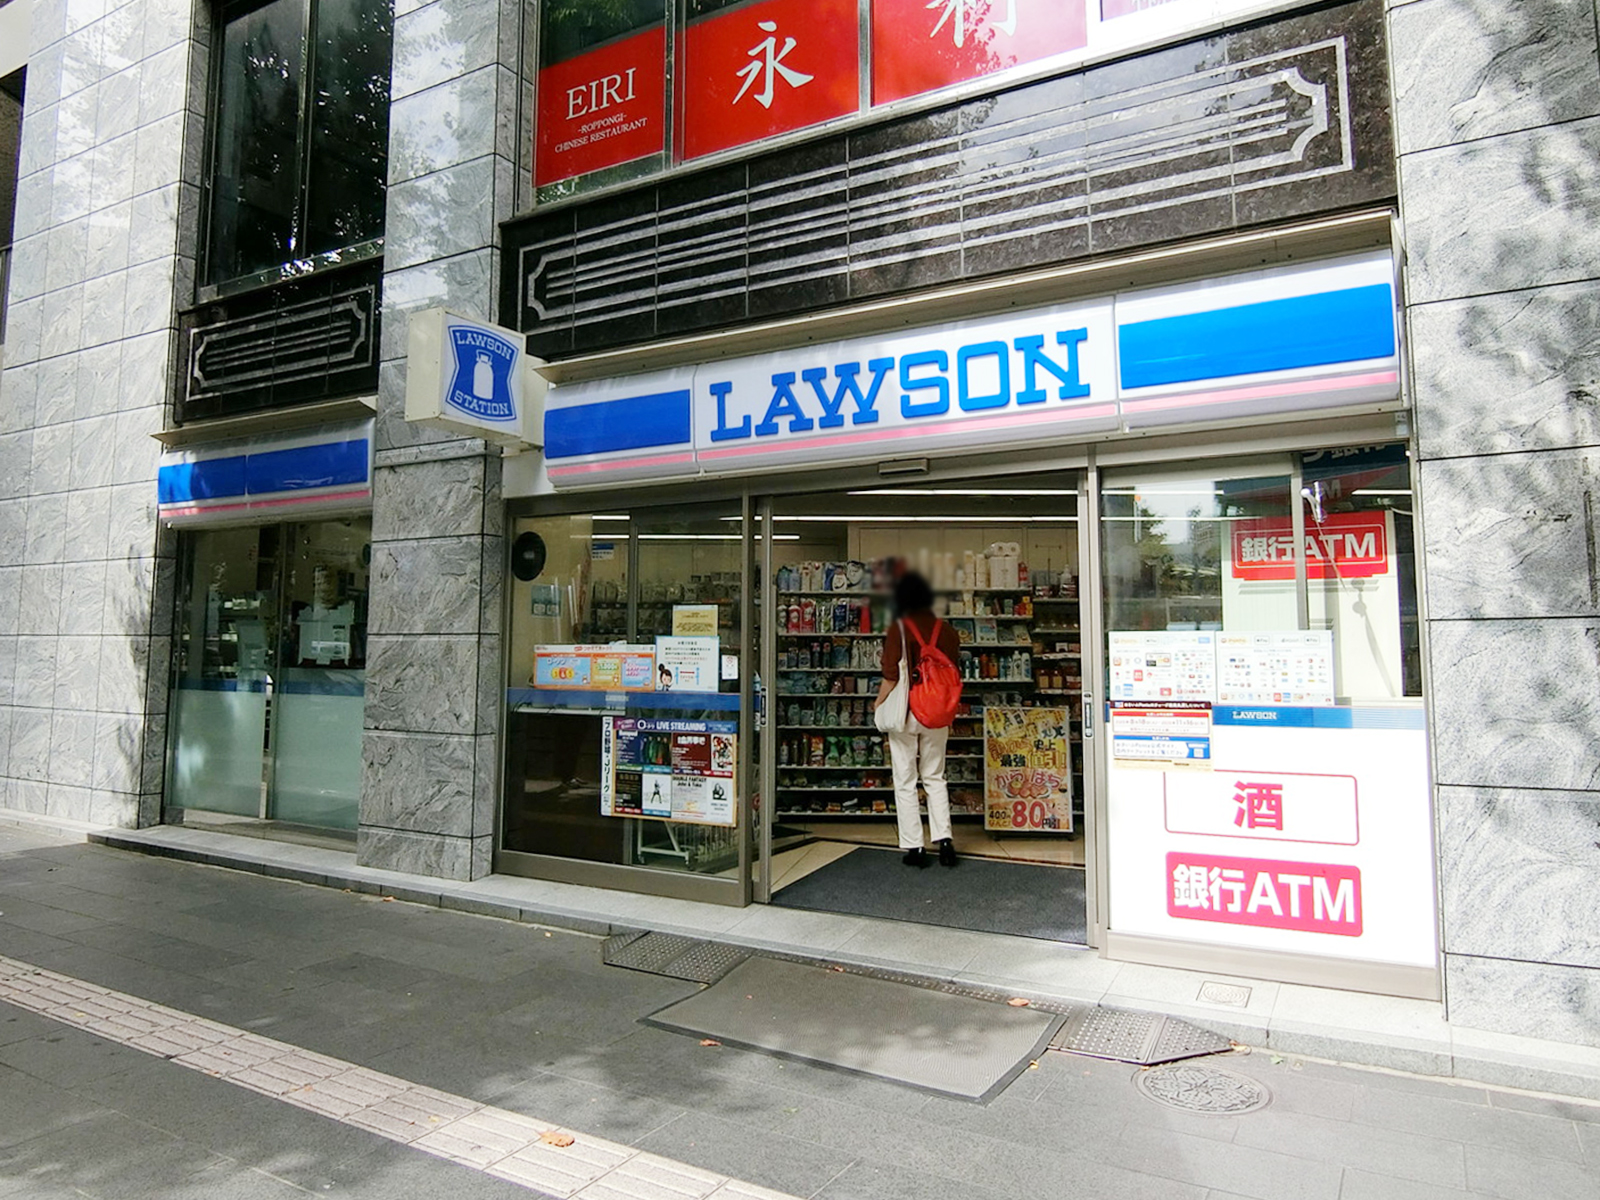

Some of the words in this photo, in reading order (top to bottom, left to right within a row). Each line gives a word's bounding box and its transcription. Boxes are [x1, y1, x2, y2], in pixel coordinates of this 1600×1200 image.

[565, 67, 637, 120] EIRI
[554, 136, 589, 153] CHINESE
[590, 117, 648, 142] RESTAURANT
[455, 332, 512, 360] LAWSON
[709, 327, 1091, 442] LAWSON
[454, 390, 509, 415] STATION
[1240, 532, 1376, 562] 銀行ATM
[656, 720, 670, 730] LIVE
[671, 721, 706, 732] STREAMING
[1232, 711, 1277, 720] LAWSON
[1232, 780, 1283, 831] 酒
[1172, 863, 1355, 924] 銀行ATM
